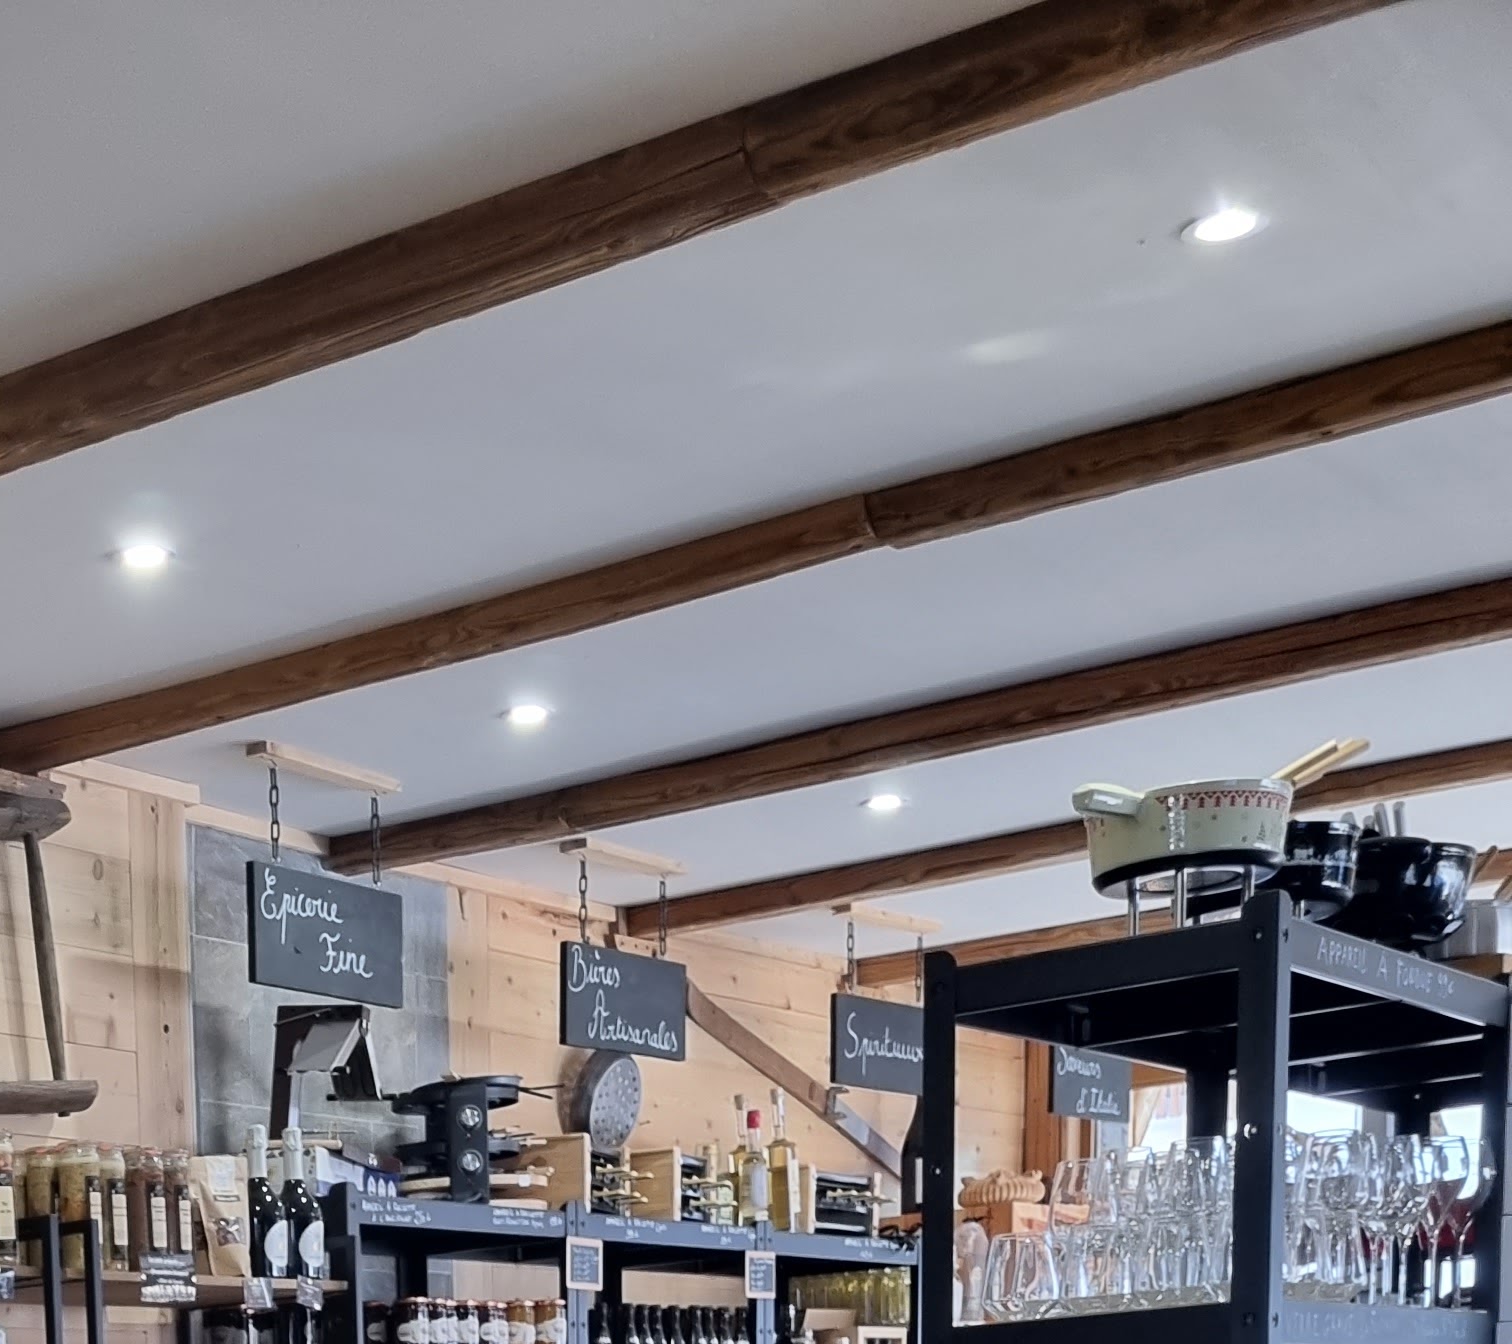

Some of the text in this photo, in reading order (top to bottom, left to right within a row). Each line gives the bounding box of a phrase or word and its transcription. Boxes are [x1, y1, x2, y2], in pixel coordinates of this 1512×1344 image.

[319, 932, 373, 978] Fine
[568, 944, 620, 992] Bières
[588, 989, 678, 1052] Artisanales
